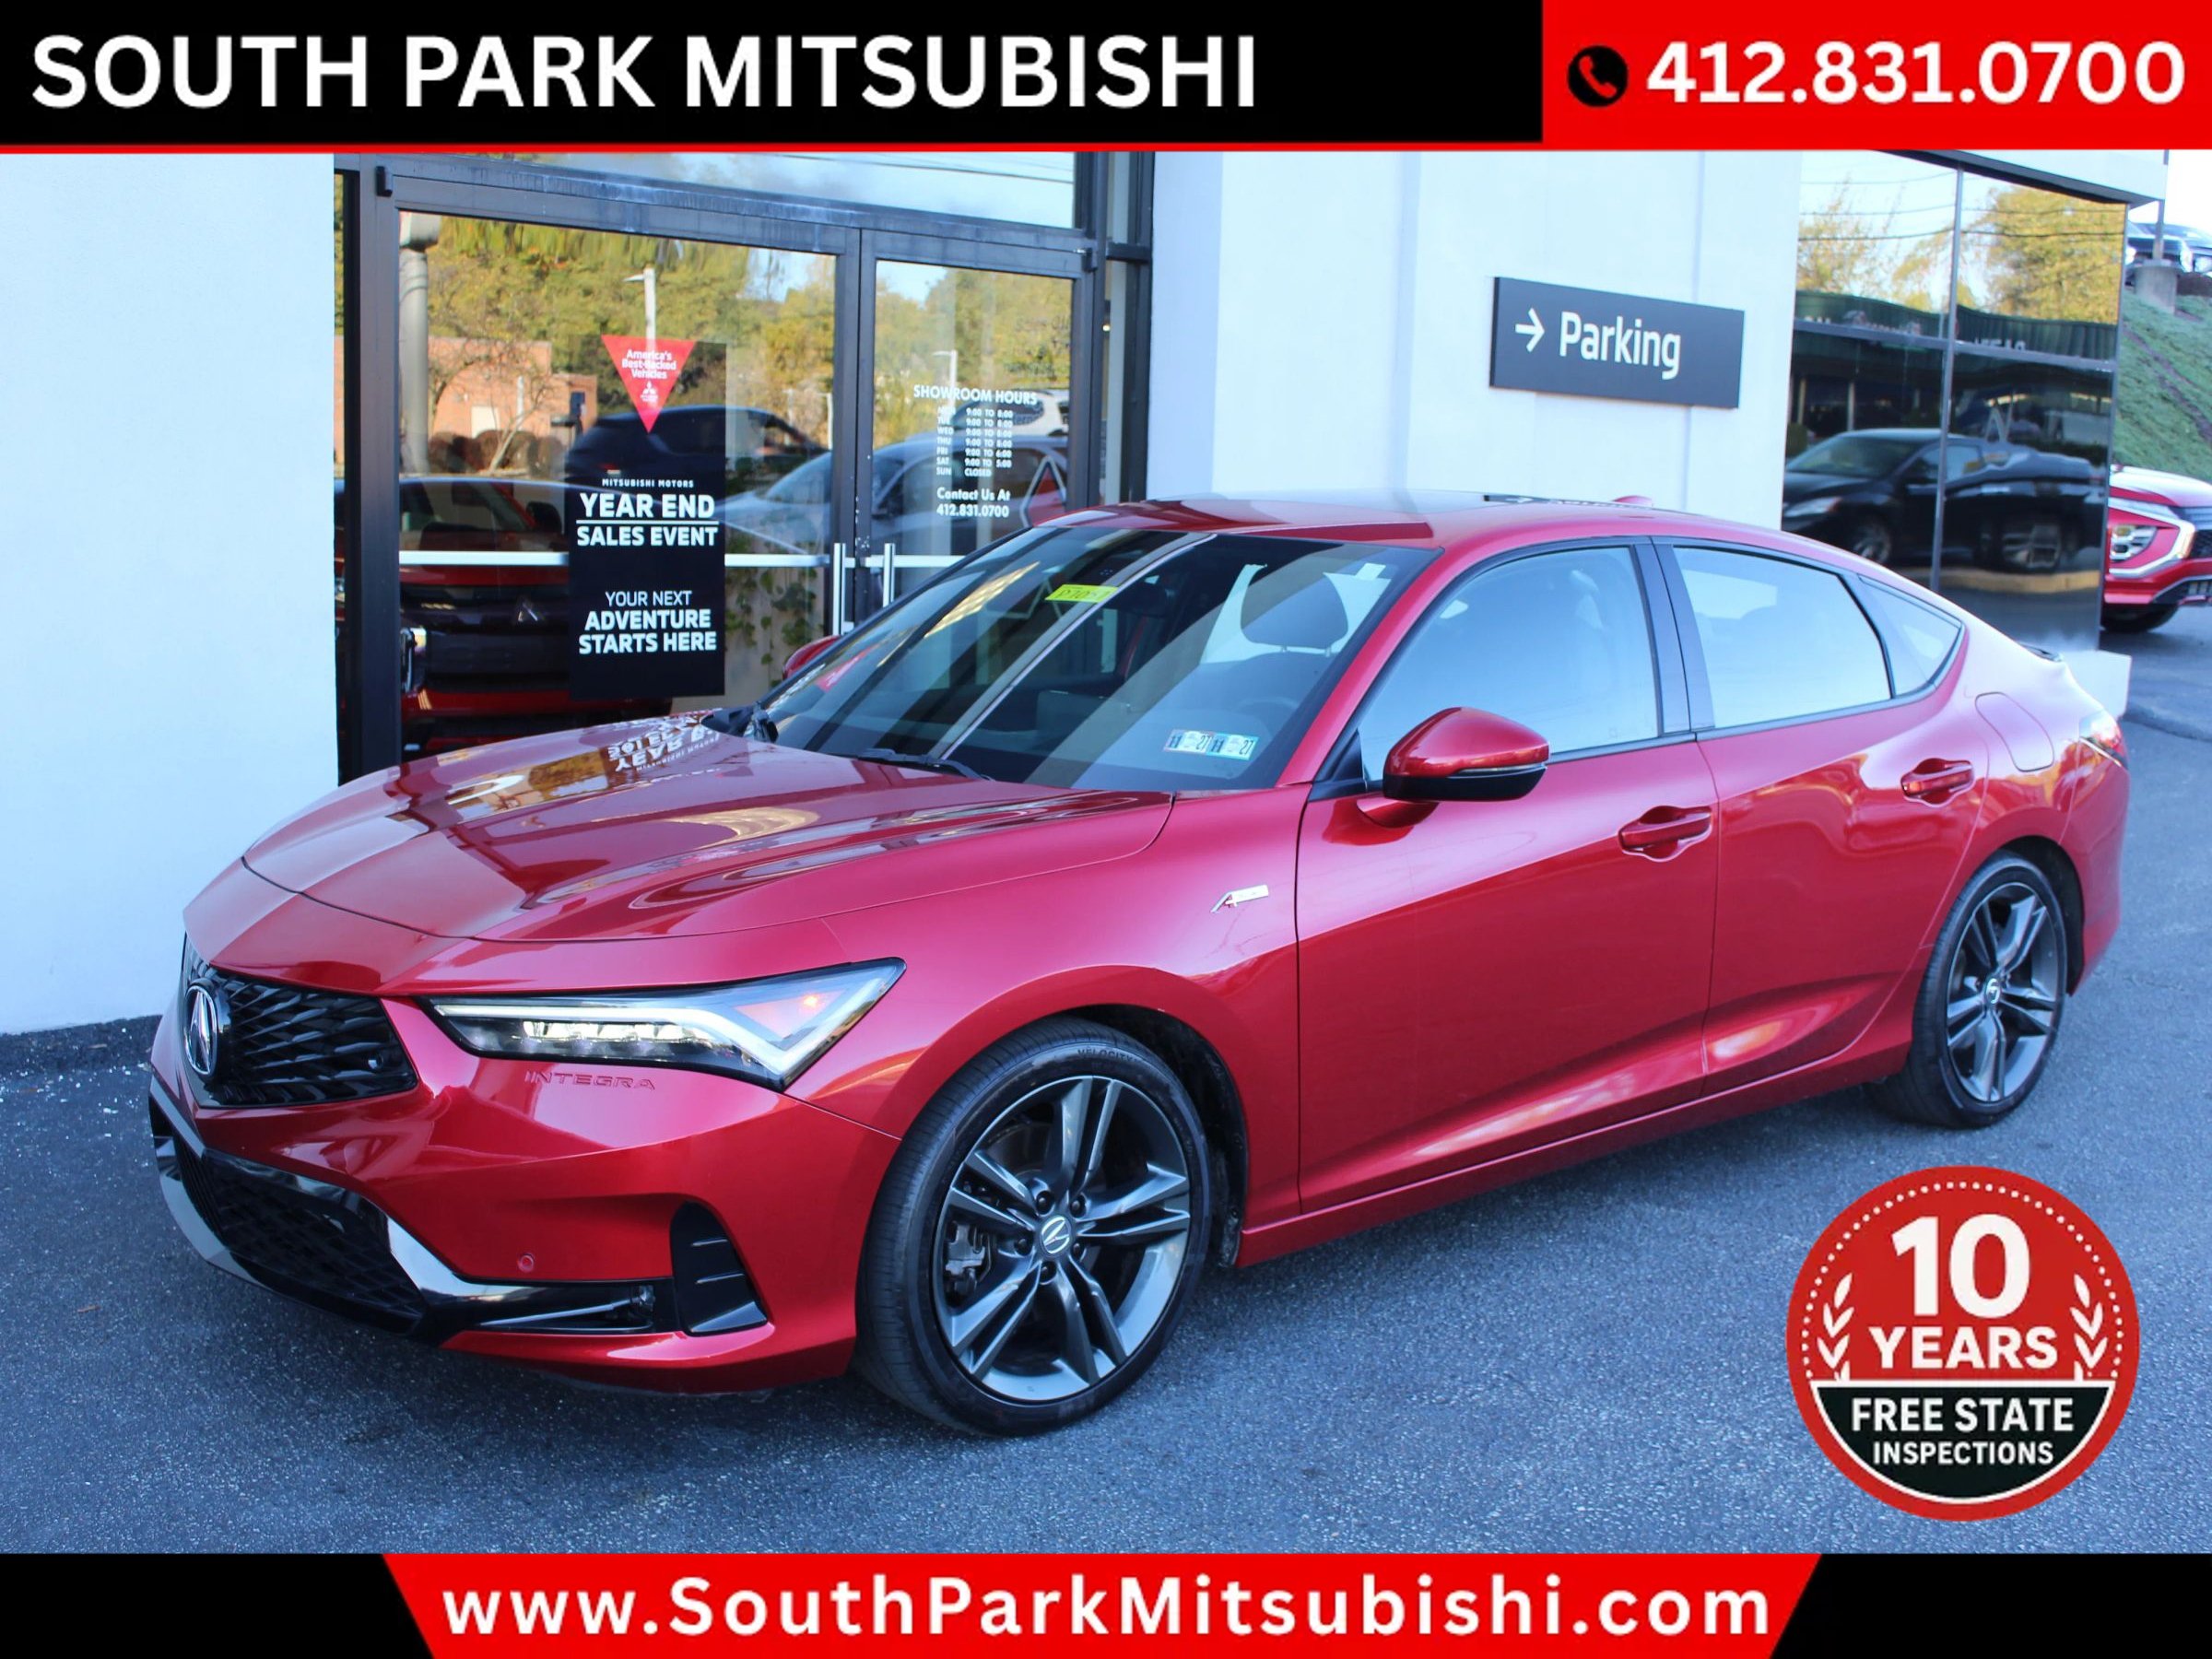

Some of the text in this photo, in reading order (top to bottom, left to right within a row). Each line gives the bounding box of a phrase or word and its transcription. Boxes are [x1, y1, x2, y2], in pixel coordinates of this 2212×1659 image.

[1559, 311, 1681, 381] Parking
[913, 384, 1037, 406] SHOWROOM HOURS
[965, 407, 982, 416] 9:00
[984, 408, 994, 418] TO
[965, 418, 981, 427] 9:00
[984, 418, 994, 427] TO
[936, 427, 954, 435] WED
[965, 428, 981, 436] 9:00
[984, 429, 994, 437] TO
[936, 437, 952, 445] THU
[965, 438, 981, 446] 9:00
[983, 439, 994, 447] TO
[935, 446, 949, 455] FRI
[965, 447, 981, 456] 9:00
[983, 449, 994, 457] TO
[936, 457, 950, 465] SAT
[964, 458, 981, 466] 9:00
[982, 459, 993, 467] TO
[936, 466, 992, 477] SUN CLOSED
[602, 478, 694, 488] MITSUBISHI MOTORS
[936, 487, 1010, 501] Contact Us At
[579, 492, 715, 518] YEAR END
[936, 503, 1009, 518] 412.831.0700
[577, 525, 718, 547] SALES EVENT
[605, 590, 692, 606] YOUR NEXT
[584, 608, 712, 630] ADVENTURE
[578, 631, 717, 655] STARTS HERE
[1196, 735, 1211, 750] 27
[1211, 739, 1254, 755] 11 27
[524, 1070, 656, 1090] INTEGRA
